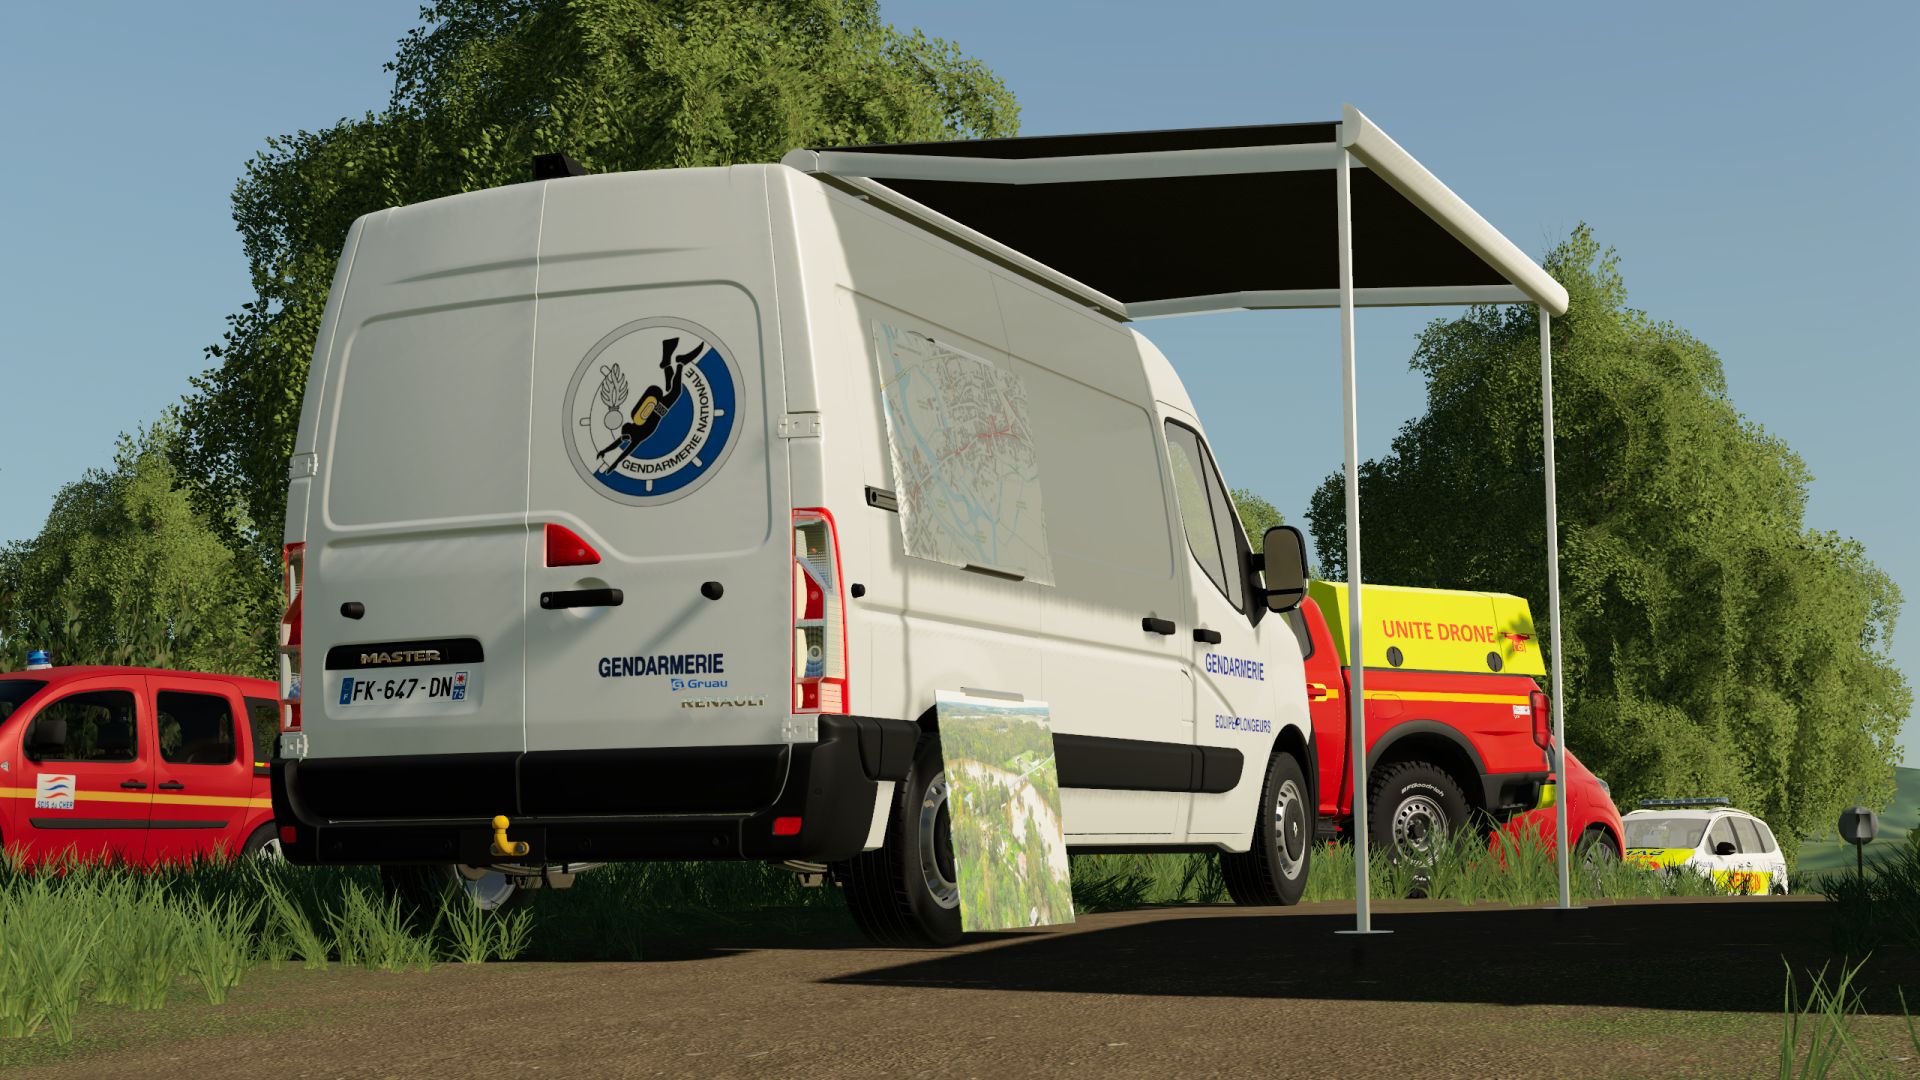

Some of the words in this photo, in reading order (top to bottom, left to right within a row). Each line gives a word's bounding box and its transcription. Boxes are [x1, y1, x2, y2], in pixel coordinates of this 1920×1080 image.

[621, 435, 701, 474] GENDARMERIE
[684, 367, 710, 433] NATIONALE
[1382, 619, 1434, 640] UNITE
[1437, 623, 1496, 643] DRONE
[360, 649, 441, 665] MASTER
[598, 653, 724, 678] GENDARMERIE
[1205, 652, 1265, 681] GENDARMERIE
[352, 676, 453, 701] FK-647-DN
[453, 689, 464, 698] 75
[687, 679, 728, 689] Gruau
[681, 694, 768, 709] RENAULT
